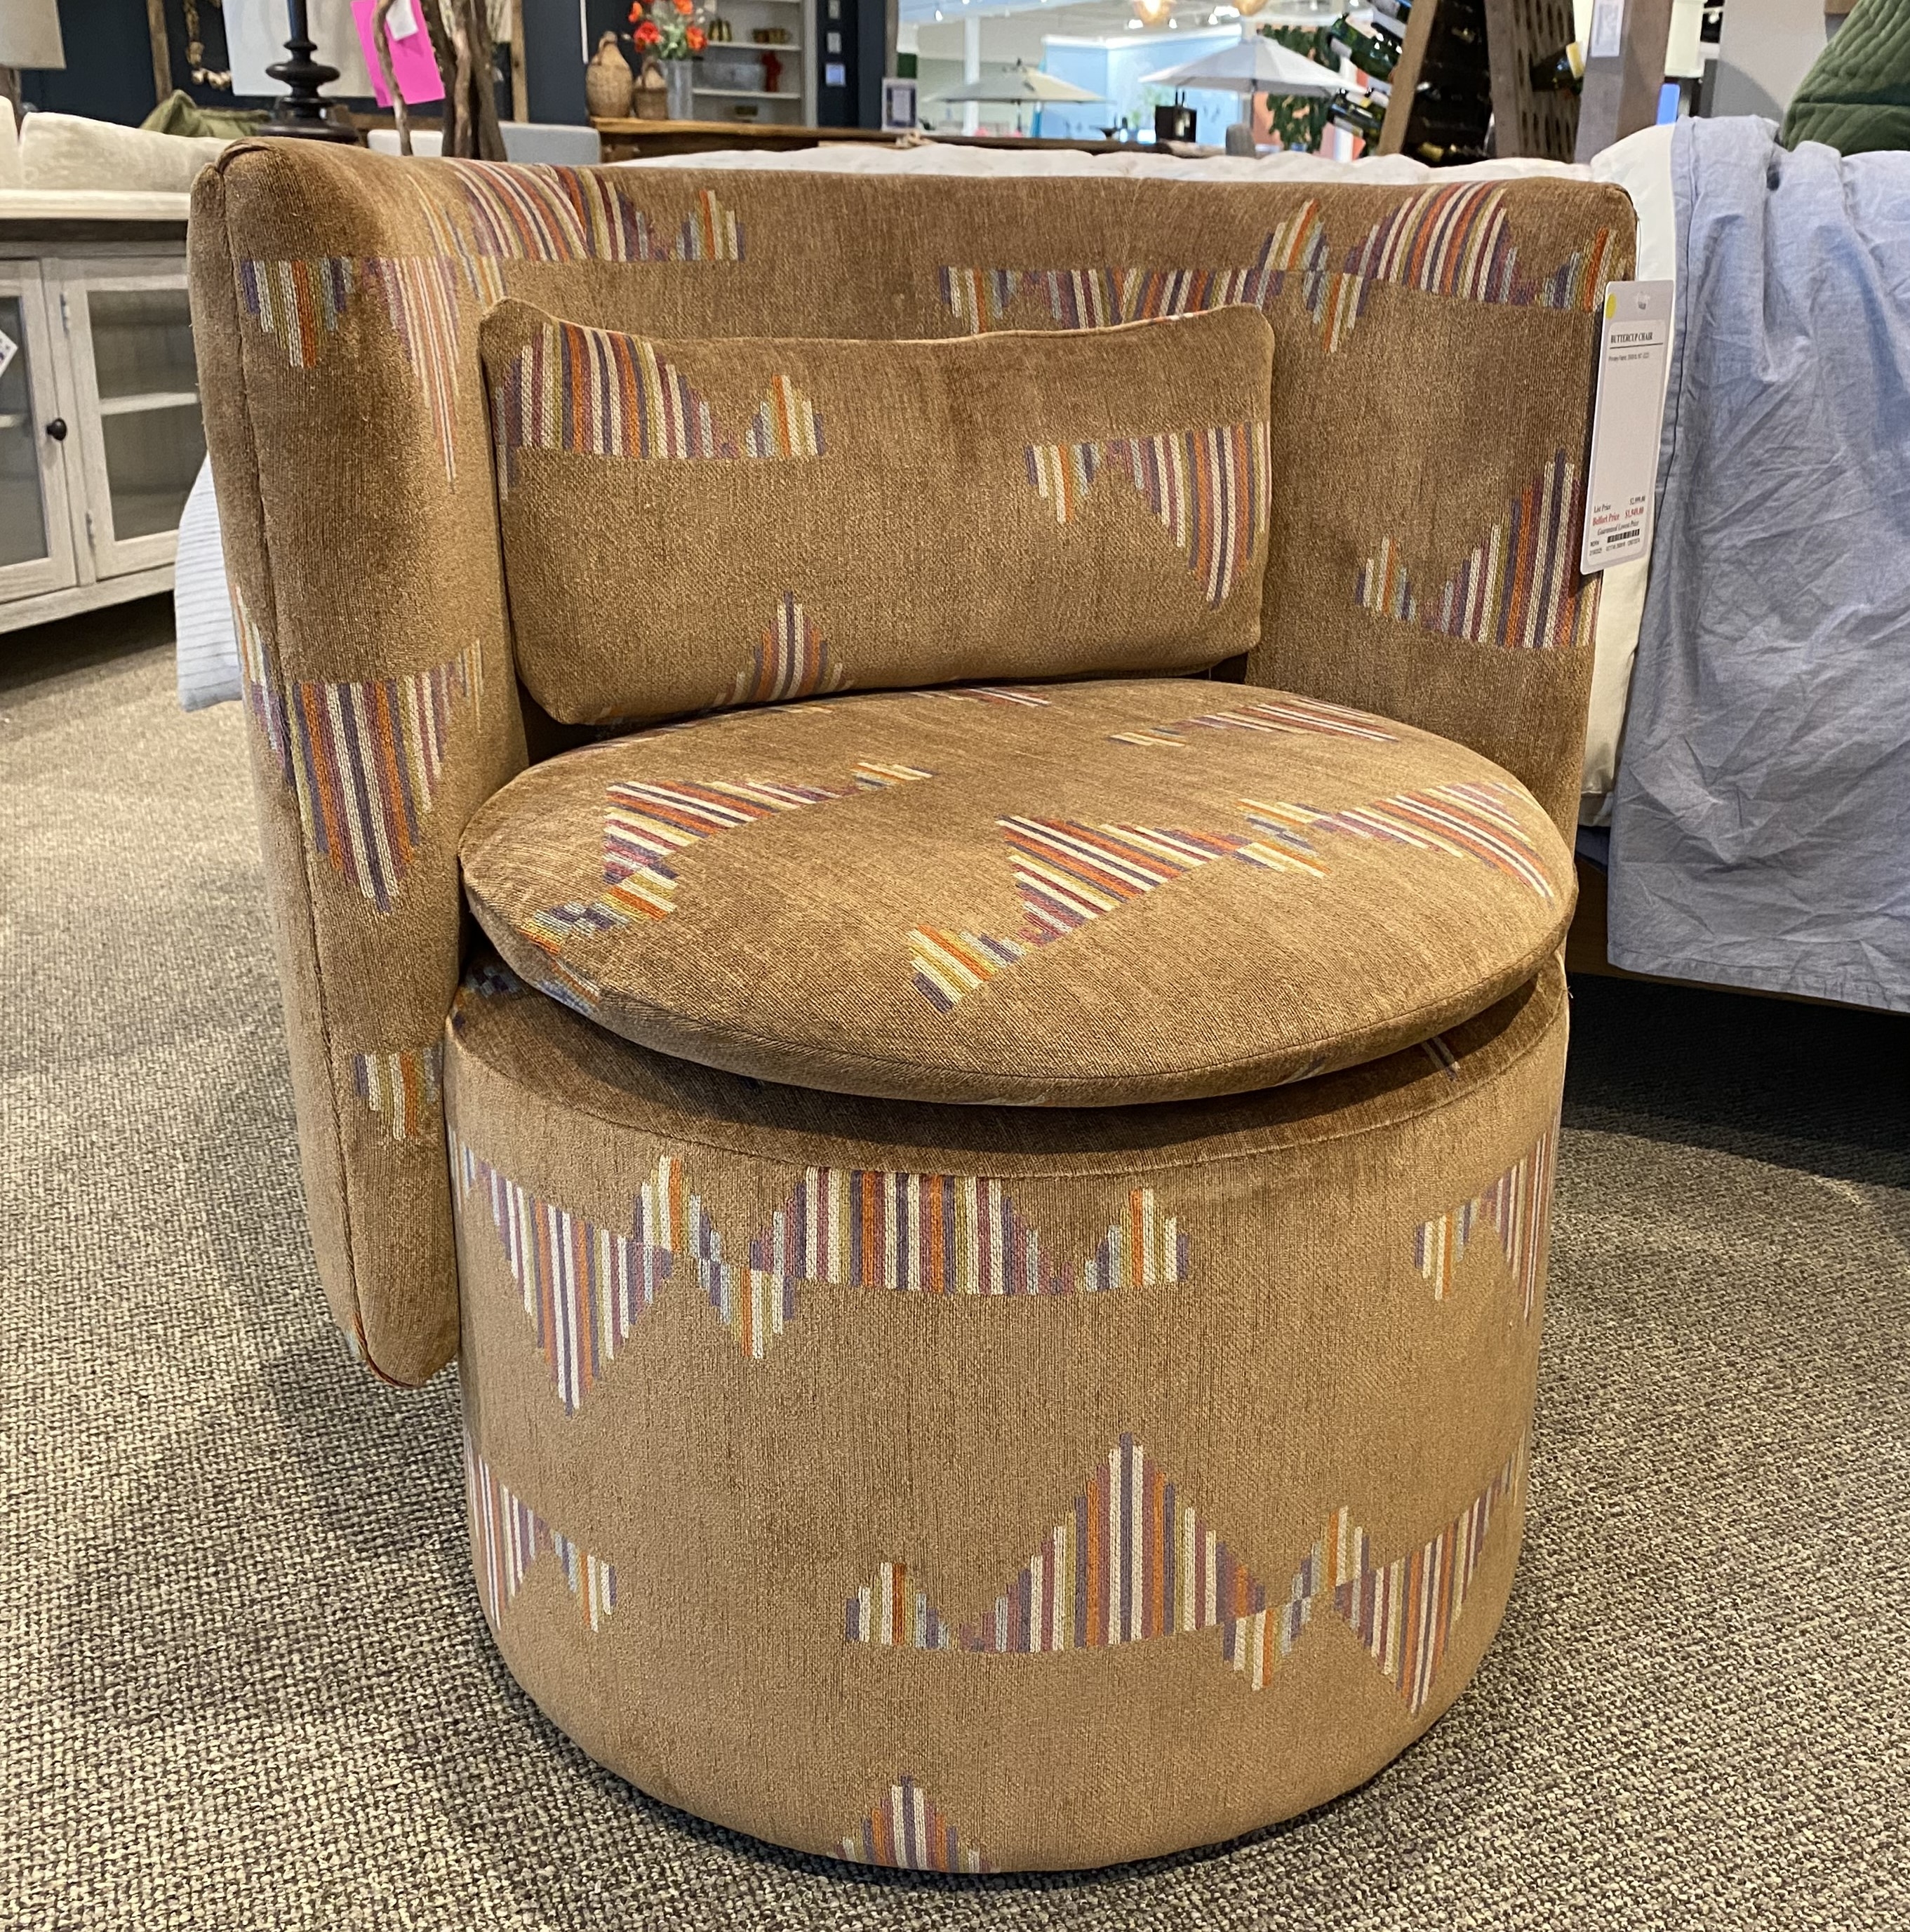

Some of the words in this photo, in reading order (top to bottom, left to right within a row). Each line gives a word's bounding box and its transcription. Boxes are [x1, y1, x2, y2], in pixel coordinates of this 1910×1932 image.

[1610, 333, 1638, 343] BUTTERCUP
[1638, 331, 1653, 341] CHAIR
[1601, 502, 1611, 512] Price
[1608, 512, 1620, 522] Price
